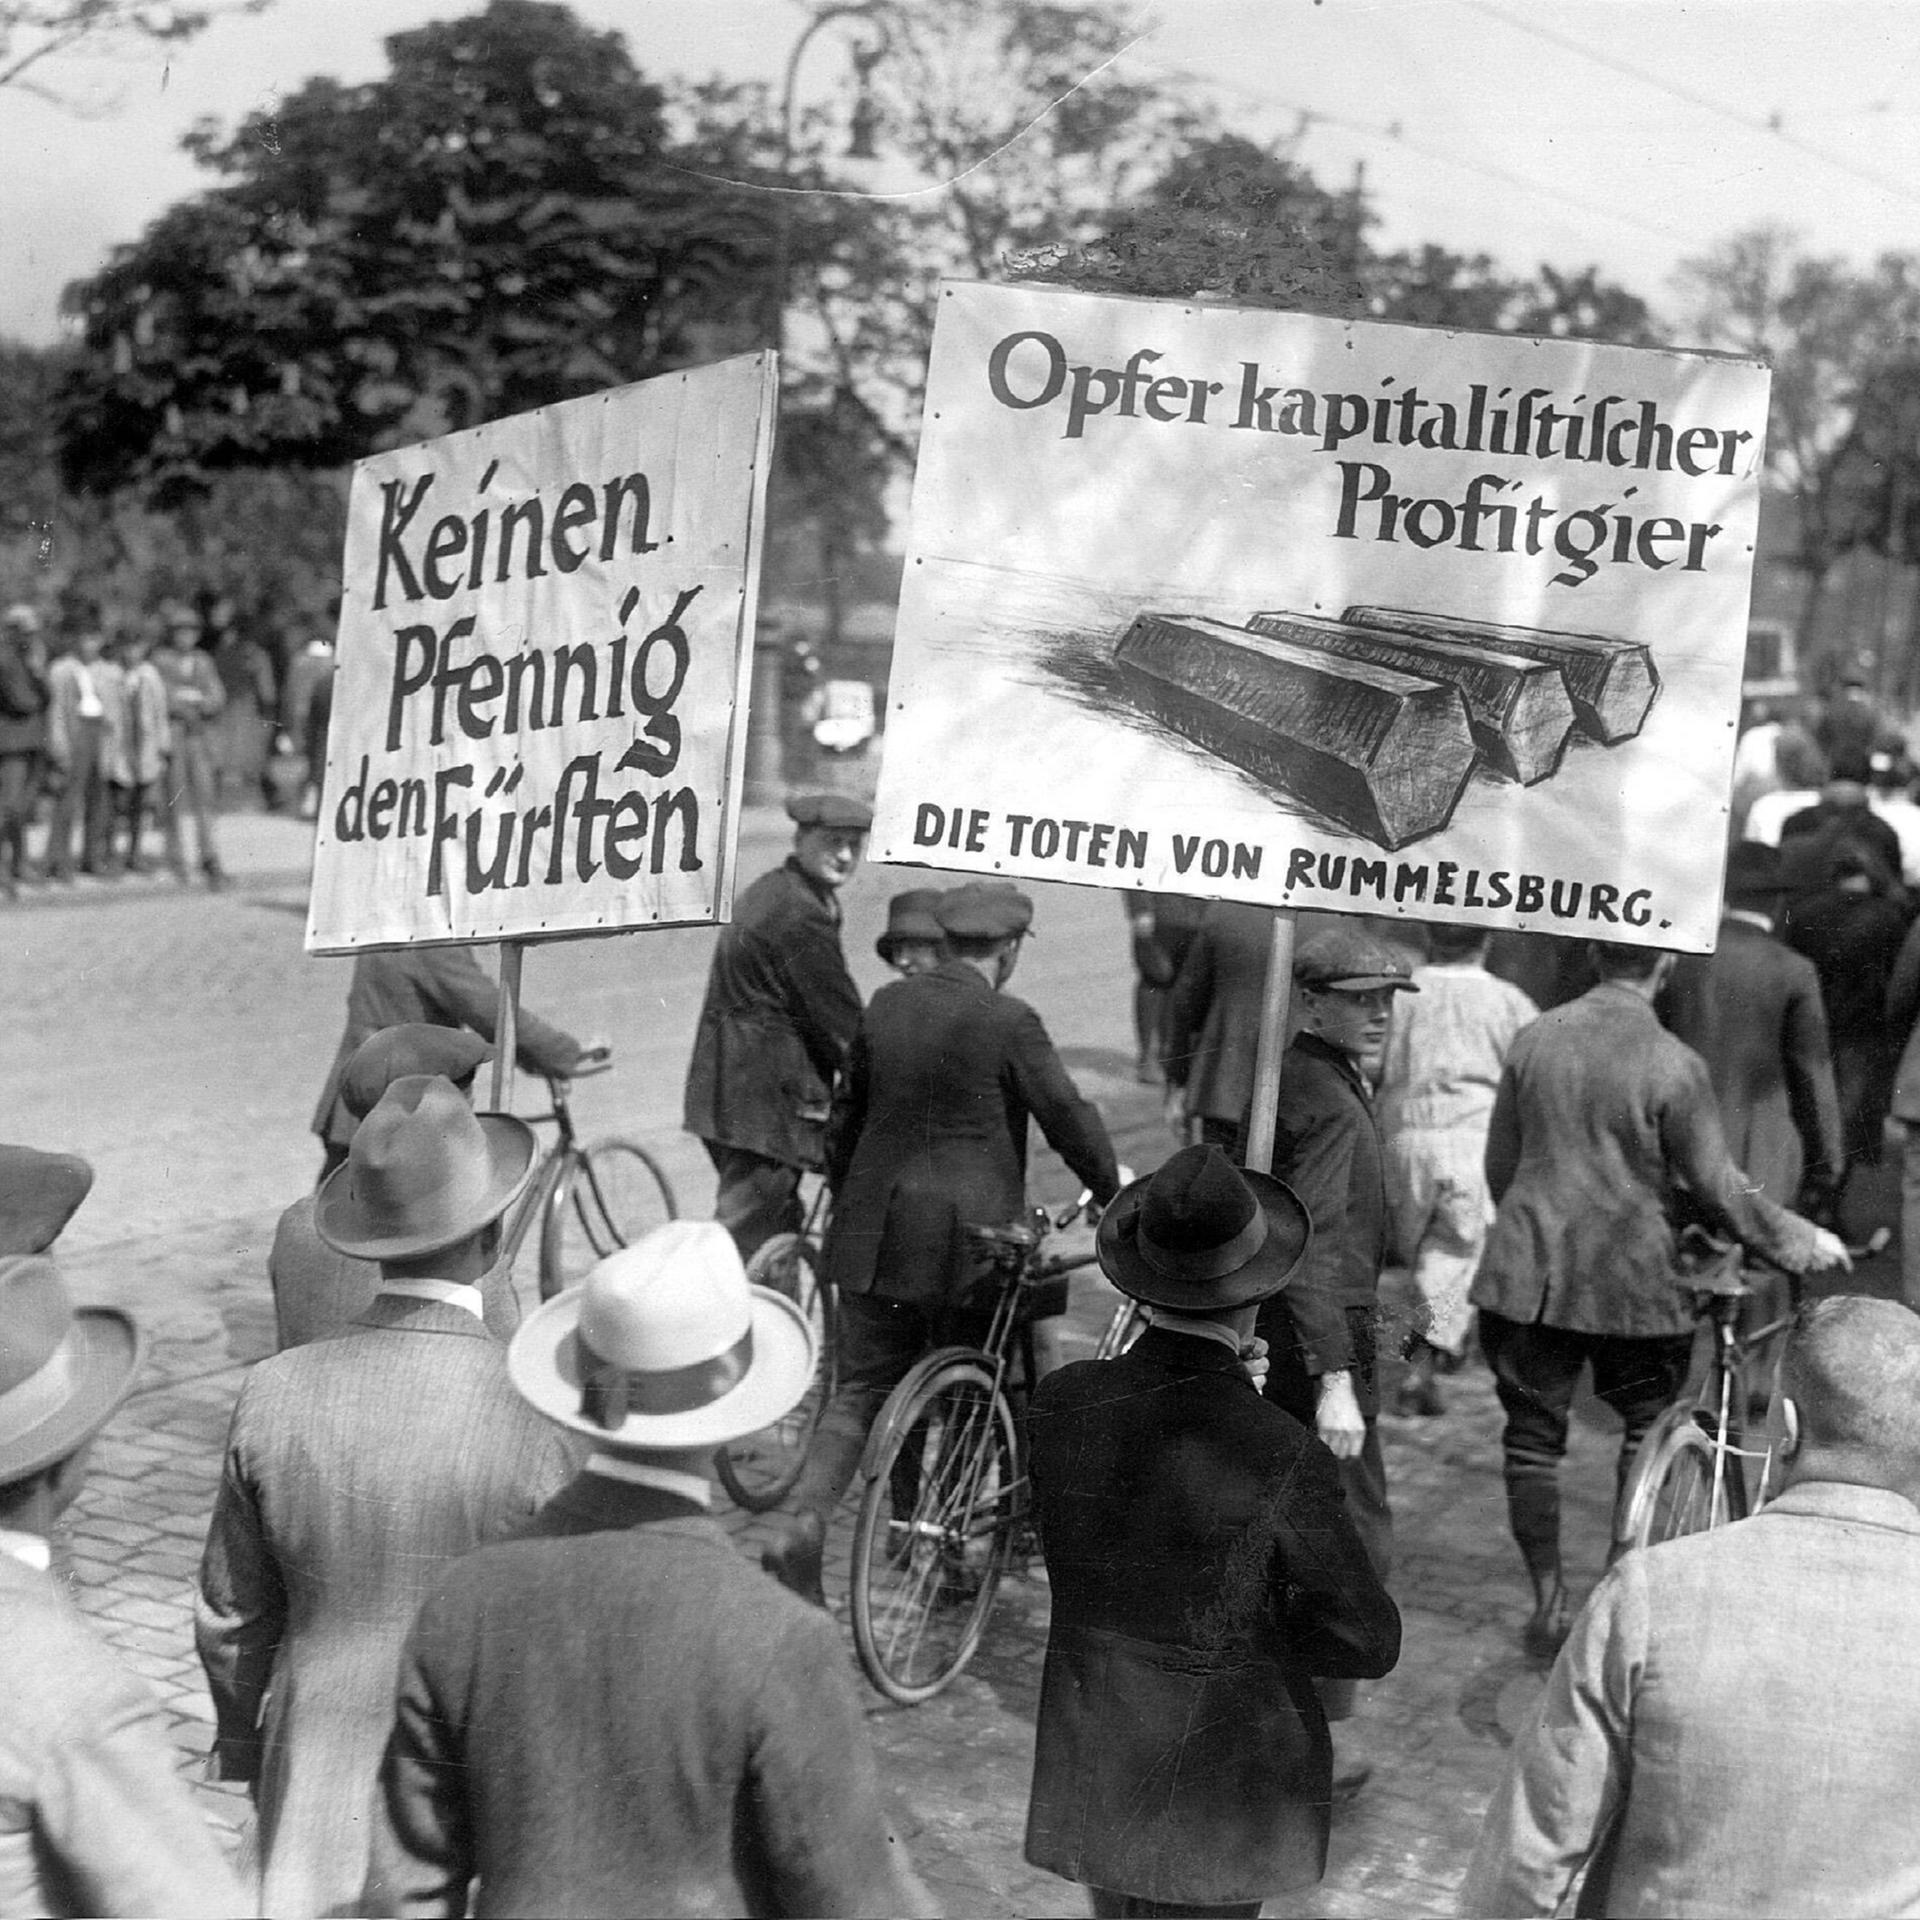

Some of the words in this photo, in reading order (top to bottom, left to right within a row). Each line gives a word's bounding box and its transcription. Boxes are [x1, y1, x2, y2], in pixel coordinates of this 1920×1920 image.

[989, 331, 1222, 440] Opfer
[371, 459, 659, 611] Keinen
[1331, 460, 1723, 588] Profitgier
[385, 585, 704, 778] Pfennig
[335, 755, 427, 843] den
[915, 802, 990, 853] DIE
[1005, 813, 1149, 870] TOTEN
[1172, 835, 1262, 881] VON
[1285, 848, 1673, 929] RUMMELSBURG.
